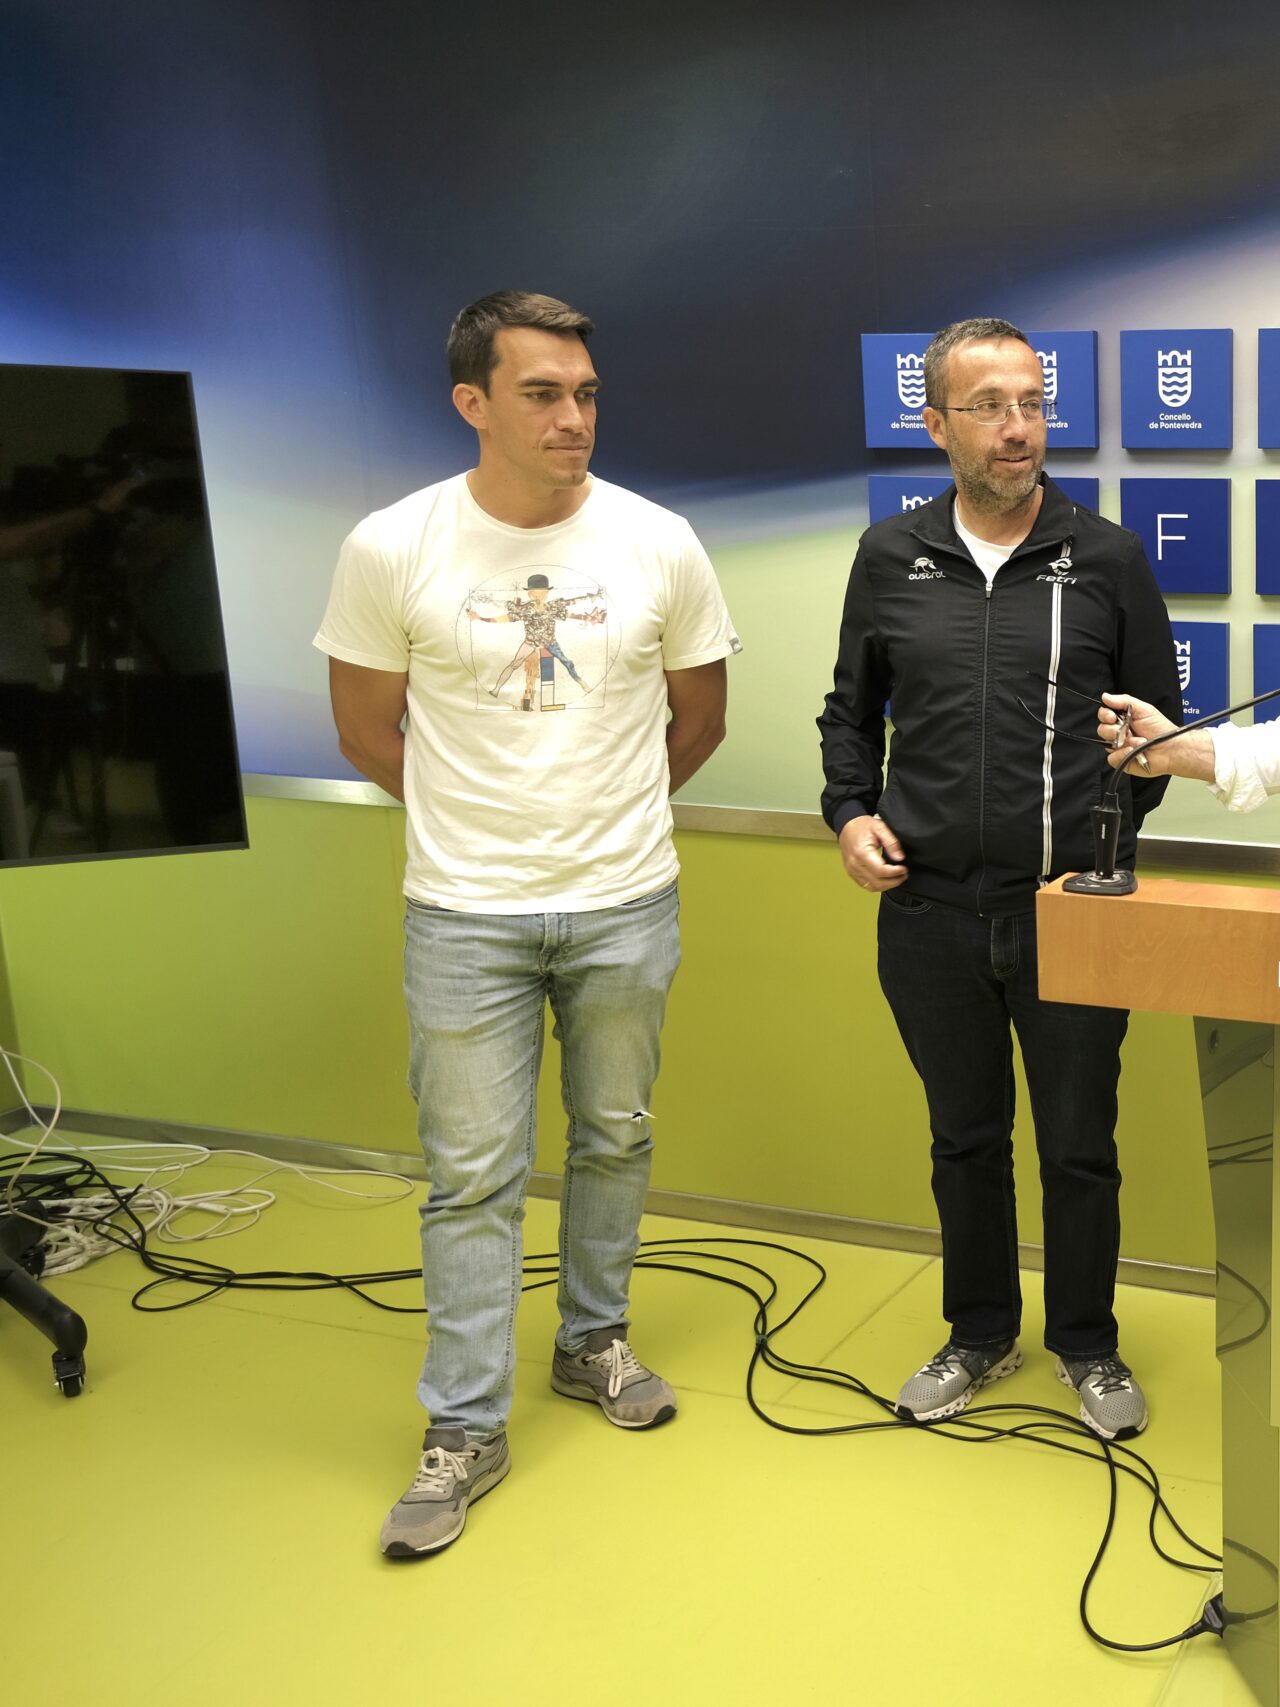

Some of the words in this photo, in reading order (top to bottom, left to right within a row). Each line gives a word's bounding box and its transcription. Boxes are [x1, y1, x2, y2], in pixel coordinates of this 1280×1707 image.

[900, 413, 925, 421] Concel
[1159, 413, 1192, 421] Concello
[890, 421, 900, 429] de
[900, 421, 927, 429] Pontev
[1047, 420, 1069, 429] vedra
[1149, 421, 1159, 429] de
[1159, 421, 1202, 429] Pontevedra
[1157, 513, 1189, 561] F
